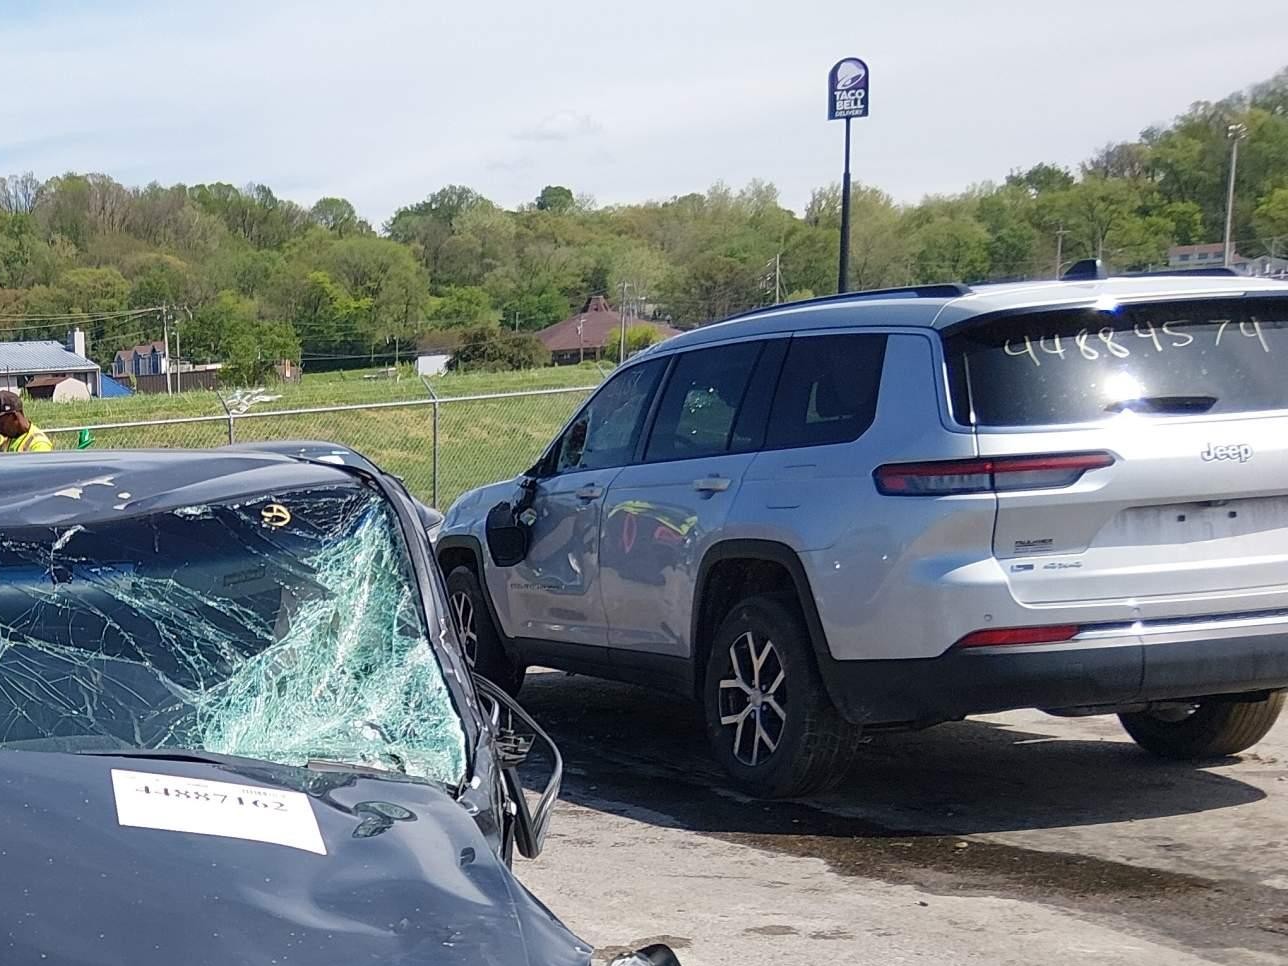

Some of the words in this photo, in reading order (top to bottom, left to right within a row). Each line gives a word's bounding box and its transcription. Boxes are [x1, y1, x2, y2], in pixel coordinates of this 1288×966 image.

[834, 89, 865, 100] TACO
[836, 99, 865, 110] BELL
[1003, 315, 1270, 368] 44884574
[1201, 442, 1253, 463] Jeep
